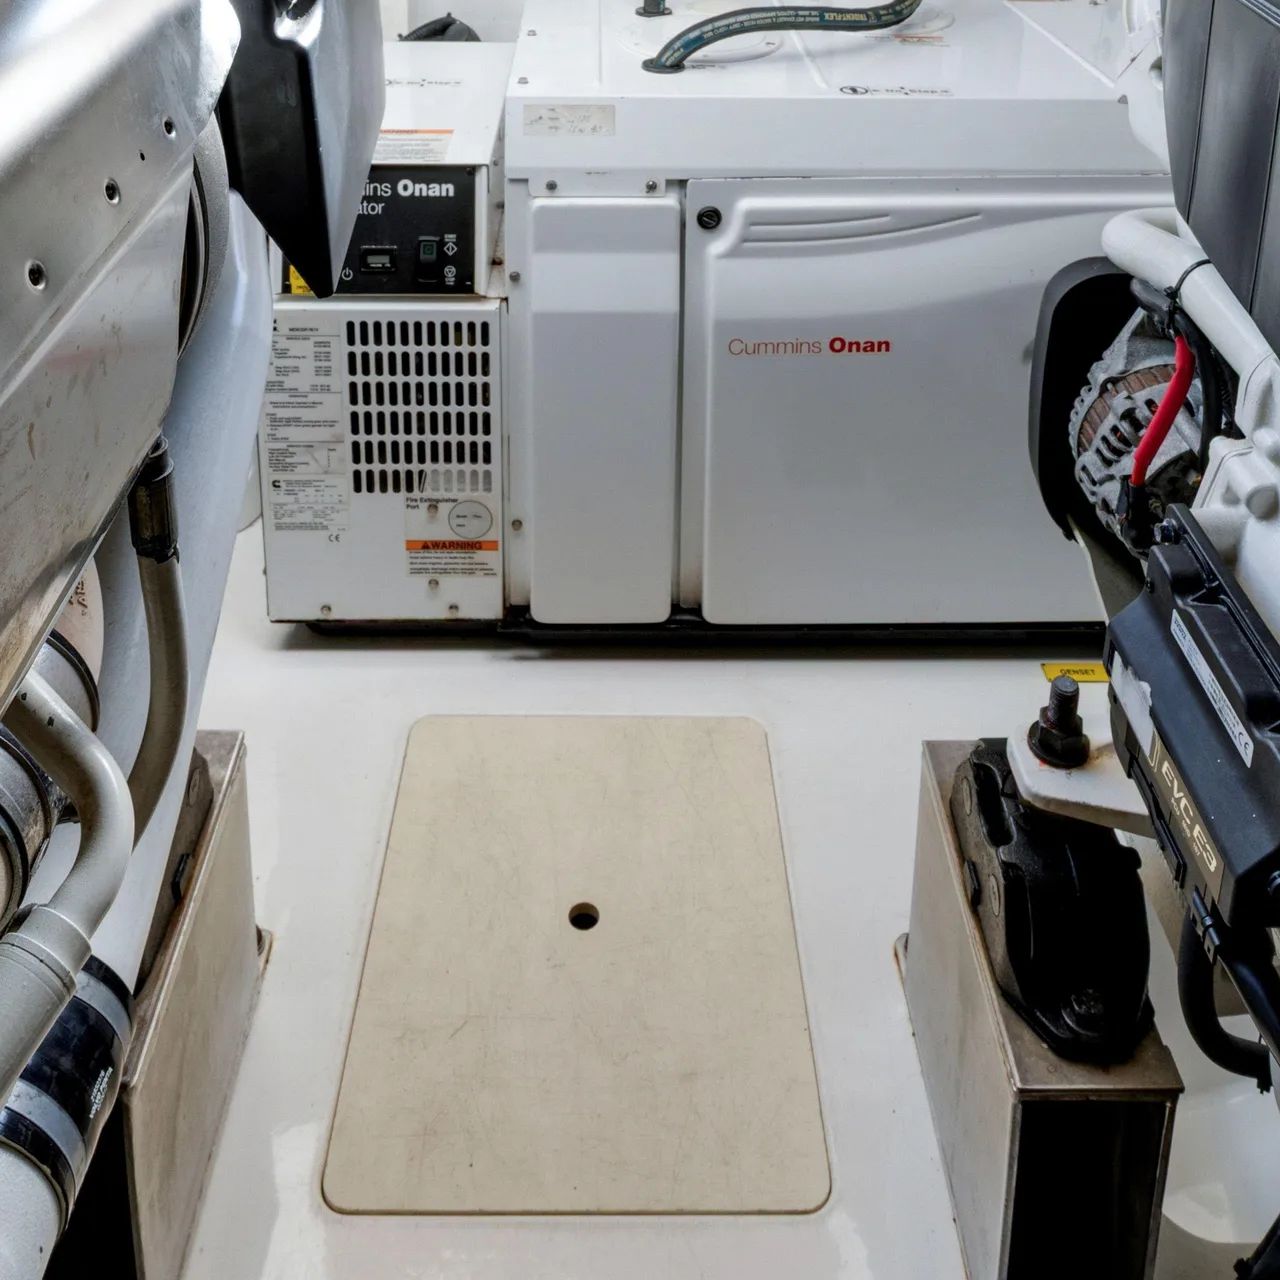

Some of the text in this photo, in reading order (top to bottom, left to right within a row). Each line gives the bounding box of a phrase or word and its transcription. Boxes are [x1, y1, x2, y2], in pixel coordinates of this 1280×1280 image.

[823, 11, 868, 22] TRIDENT-FLEX
[396, 178, 456, 198] Onan
[728, 336, 891, 356] Cummins Onan
[419, 497, 459, 505] Extinguisher
[431, 540, 483, 551] WARNING
[1059, 668, 1096, 676] GENSET
[1161, 760, 1218, 873] EVC E3
